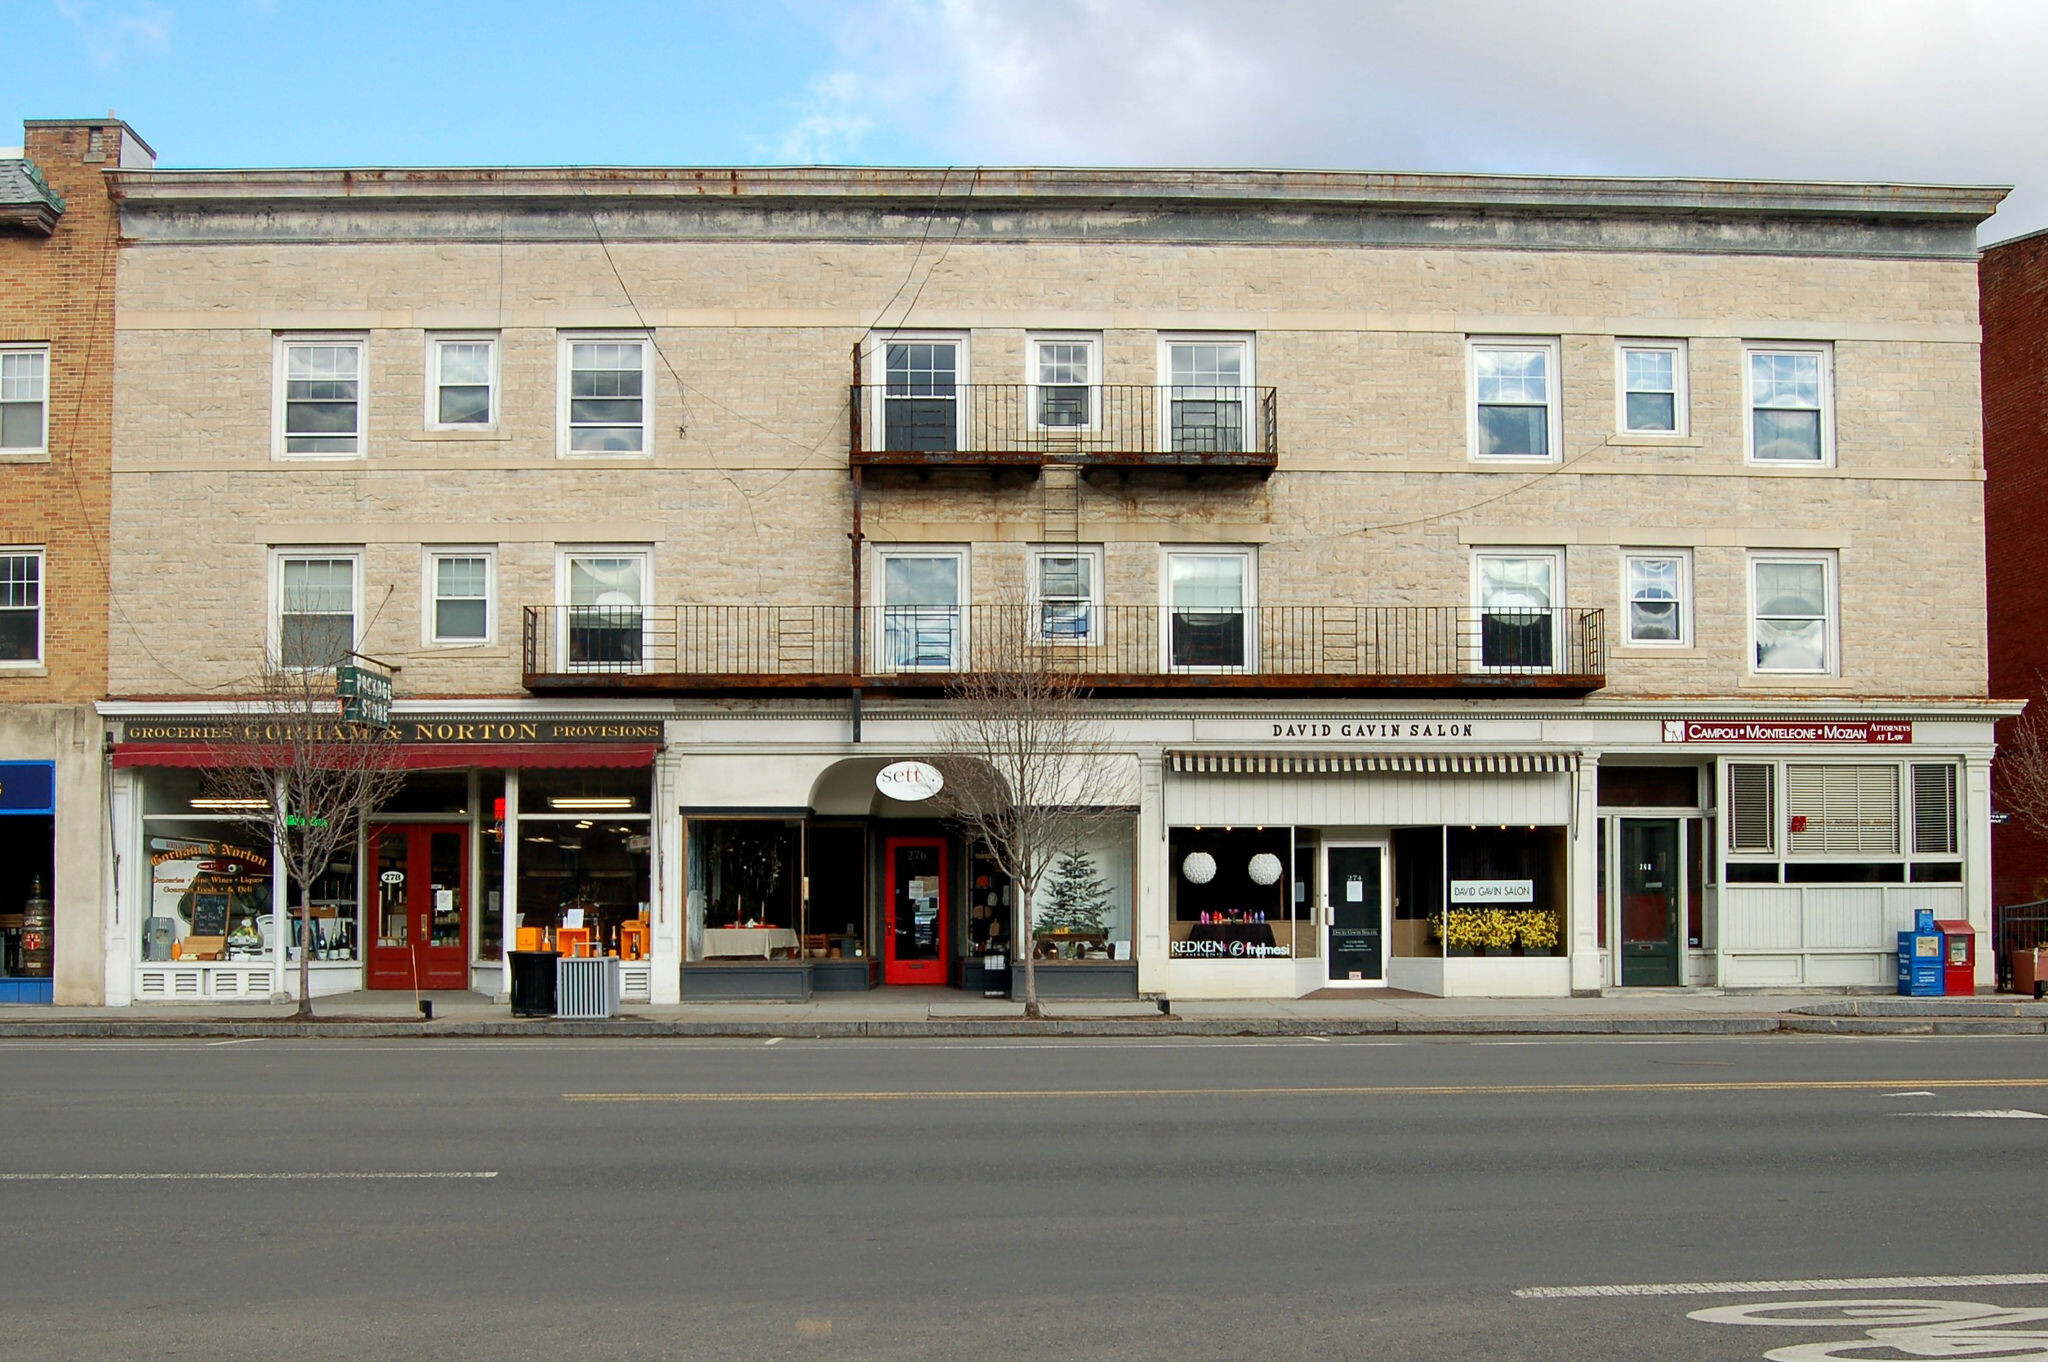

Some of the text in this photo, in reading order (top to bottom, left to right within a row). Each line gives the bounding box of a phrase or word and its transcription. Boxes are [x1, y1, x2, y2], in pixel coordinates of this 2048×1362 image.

[357, 674, 392, 701] PACKAGE
[362, 698, 388, 723] STORE
[130, 726, 233, 738] GROCERIES
[383, 724, 403, 740] &
[415, 723, 538, 740] NORTON
[552, 725, 660, 737] PROVISIONS
[1272, 724, 1473, 738] DAVID GAVIN SALON
[1688, 724, 1867, 740] CAMPOLI MONTELEONE MOZIAN
[1869, 723, 1911, 732] ATTORNEYS
[882, 767, 920, 783] sett
[150, 846, 203, 867] Gorham
[207, 842, 217, 855] &
[221, 843, 267, 867] Norton
[908, 850, 927, 860] 276
[384, 873, 401, 881] 278
[1454, 886, 1530, 896] DAVID GAVIN SALON
[1171, 941, 1224, 953] REDKEN
[1246, 942, 1290, 956] framesi
